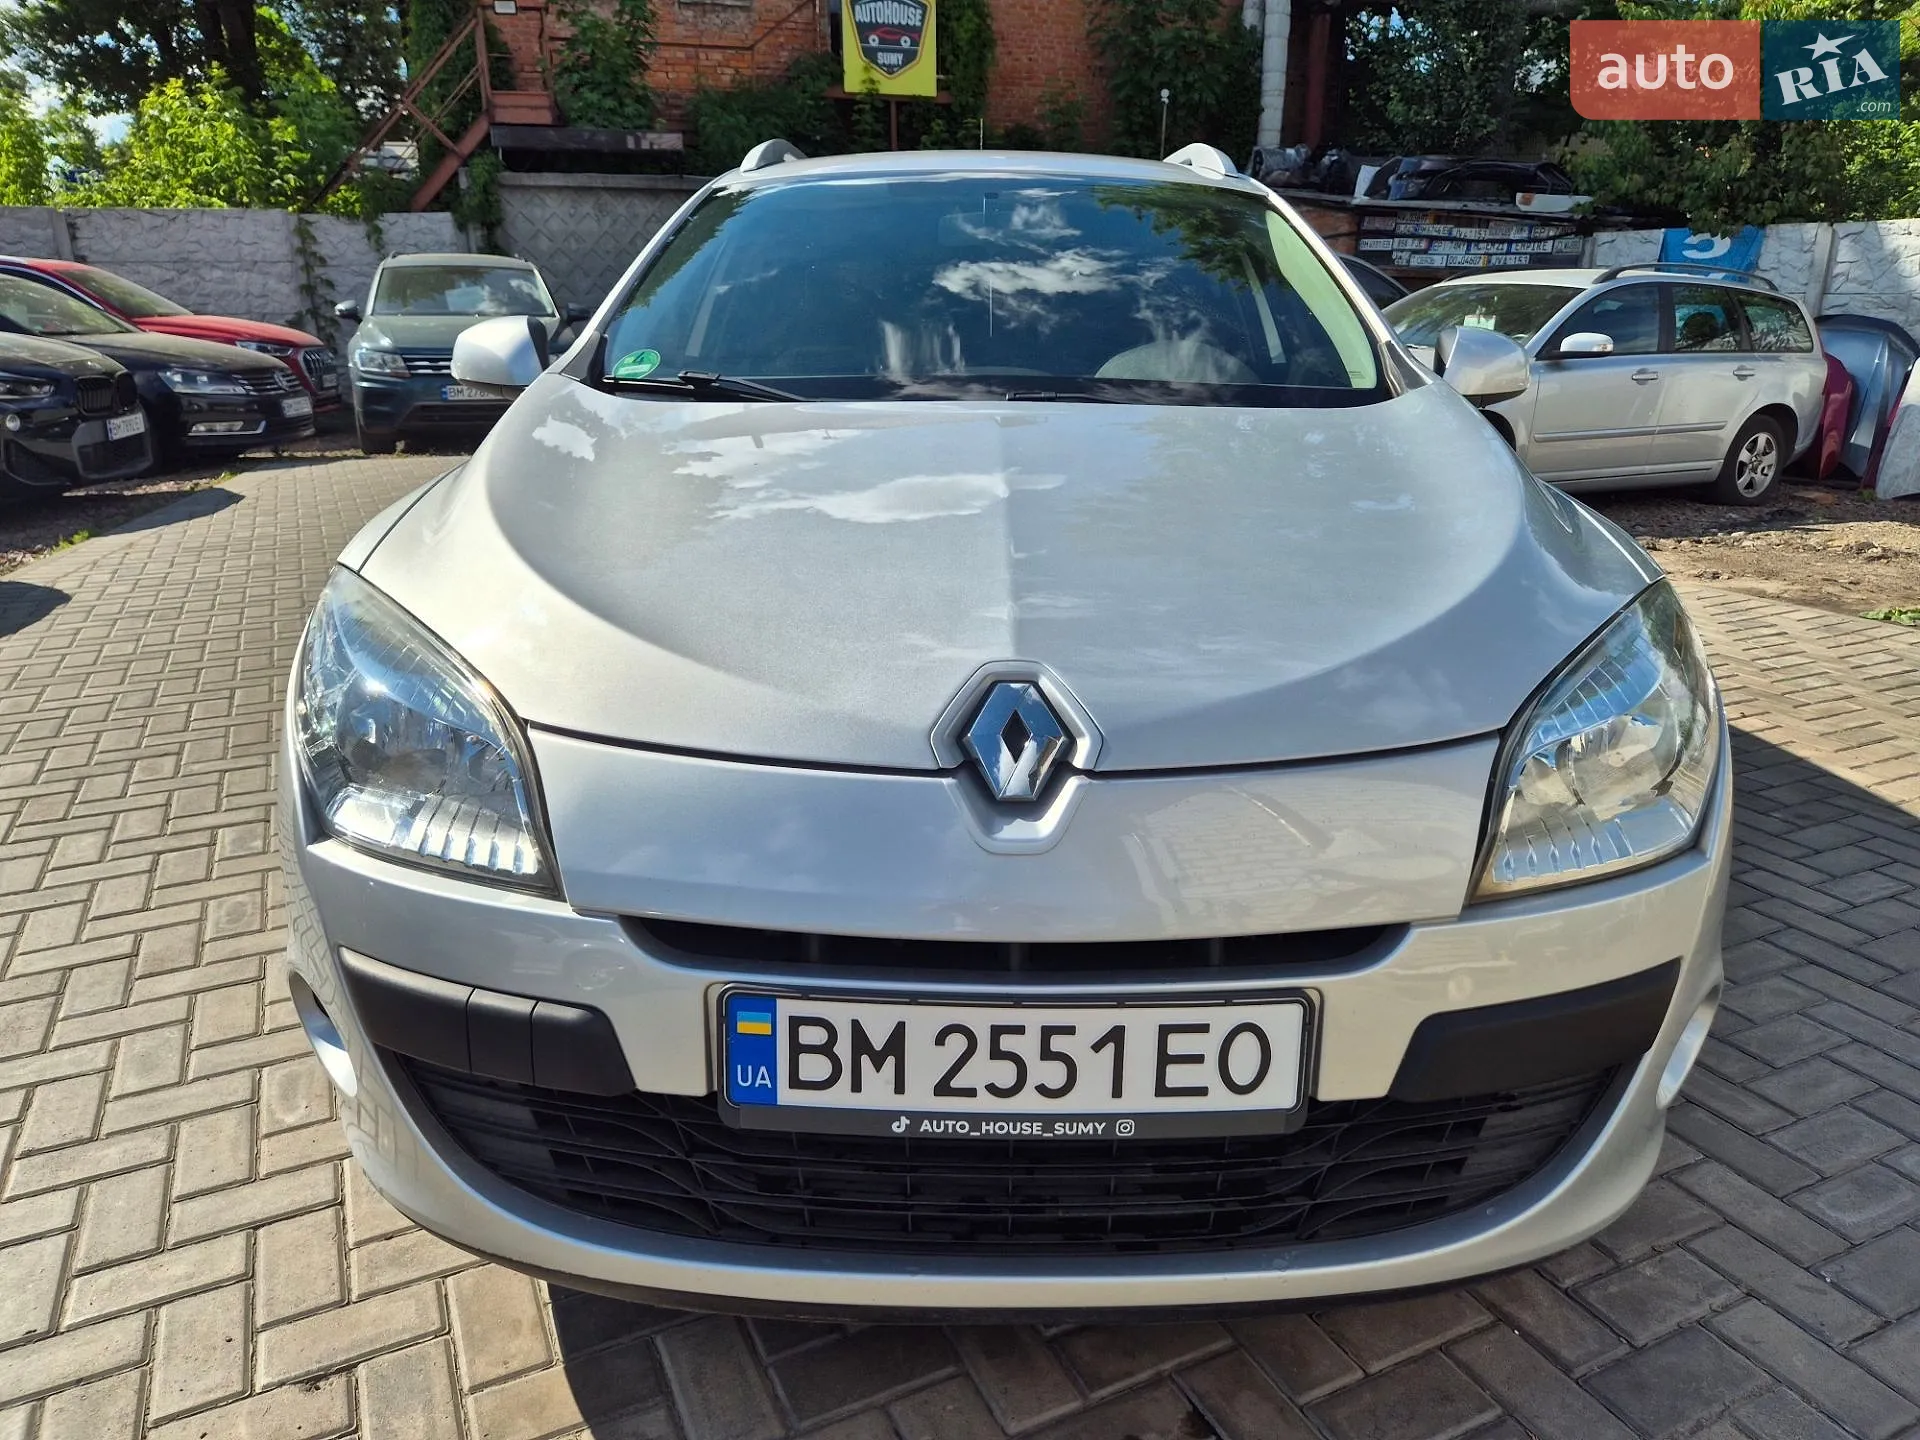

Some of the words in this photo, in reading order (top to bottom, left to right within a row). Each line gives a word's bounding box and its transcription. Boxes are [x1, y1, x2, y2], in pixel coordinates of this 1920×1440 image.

[855, 1, 922, 26] AUTOHOUSE
[877, 52, 903, 65] SUMY
[788, 1015, 906, 1095] BM
[933, 1022, 1126, 1099] 2551
[1155, 1021, 1272, 1096] EO
[737, 1065, 772, 1088] UA
[920, 1118, 1107, 1137] AUTO_HOUSE_SUMY
